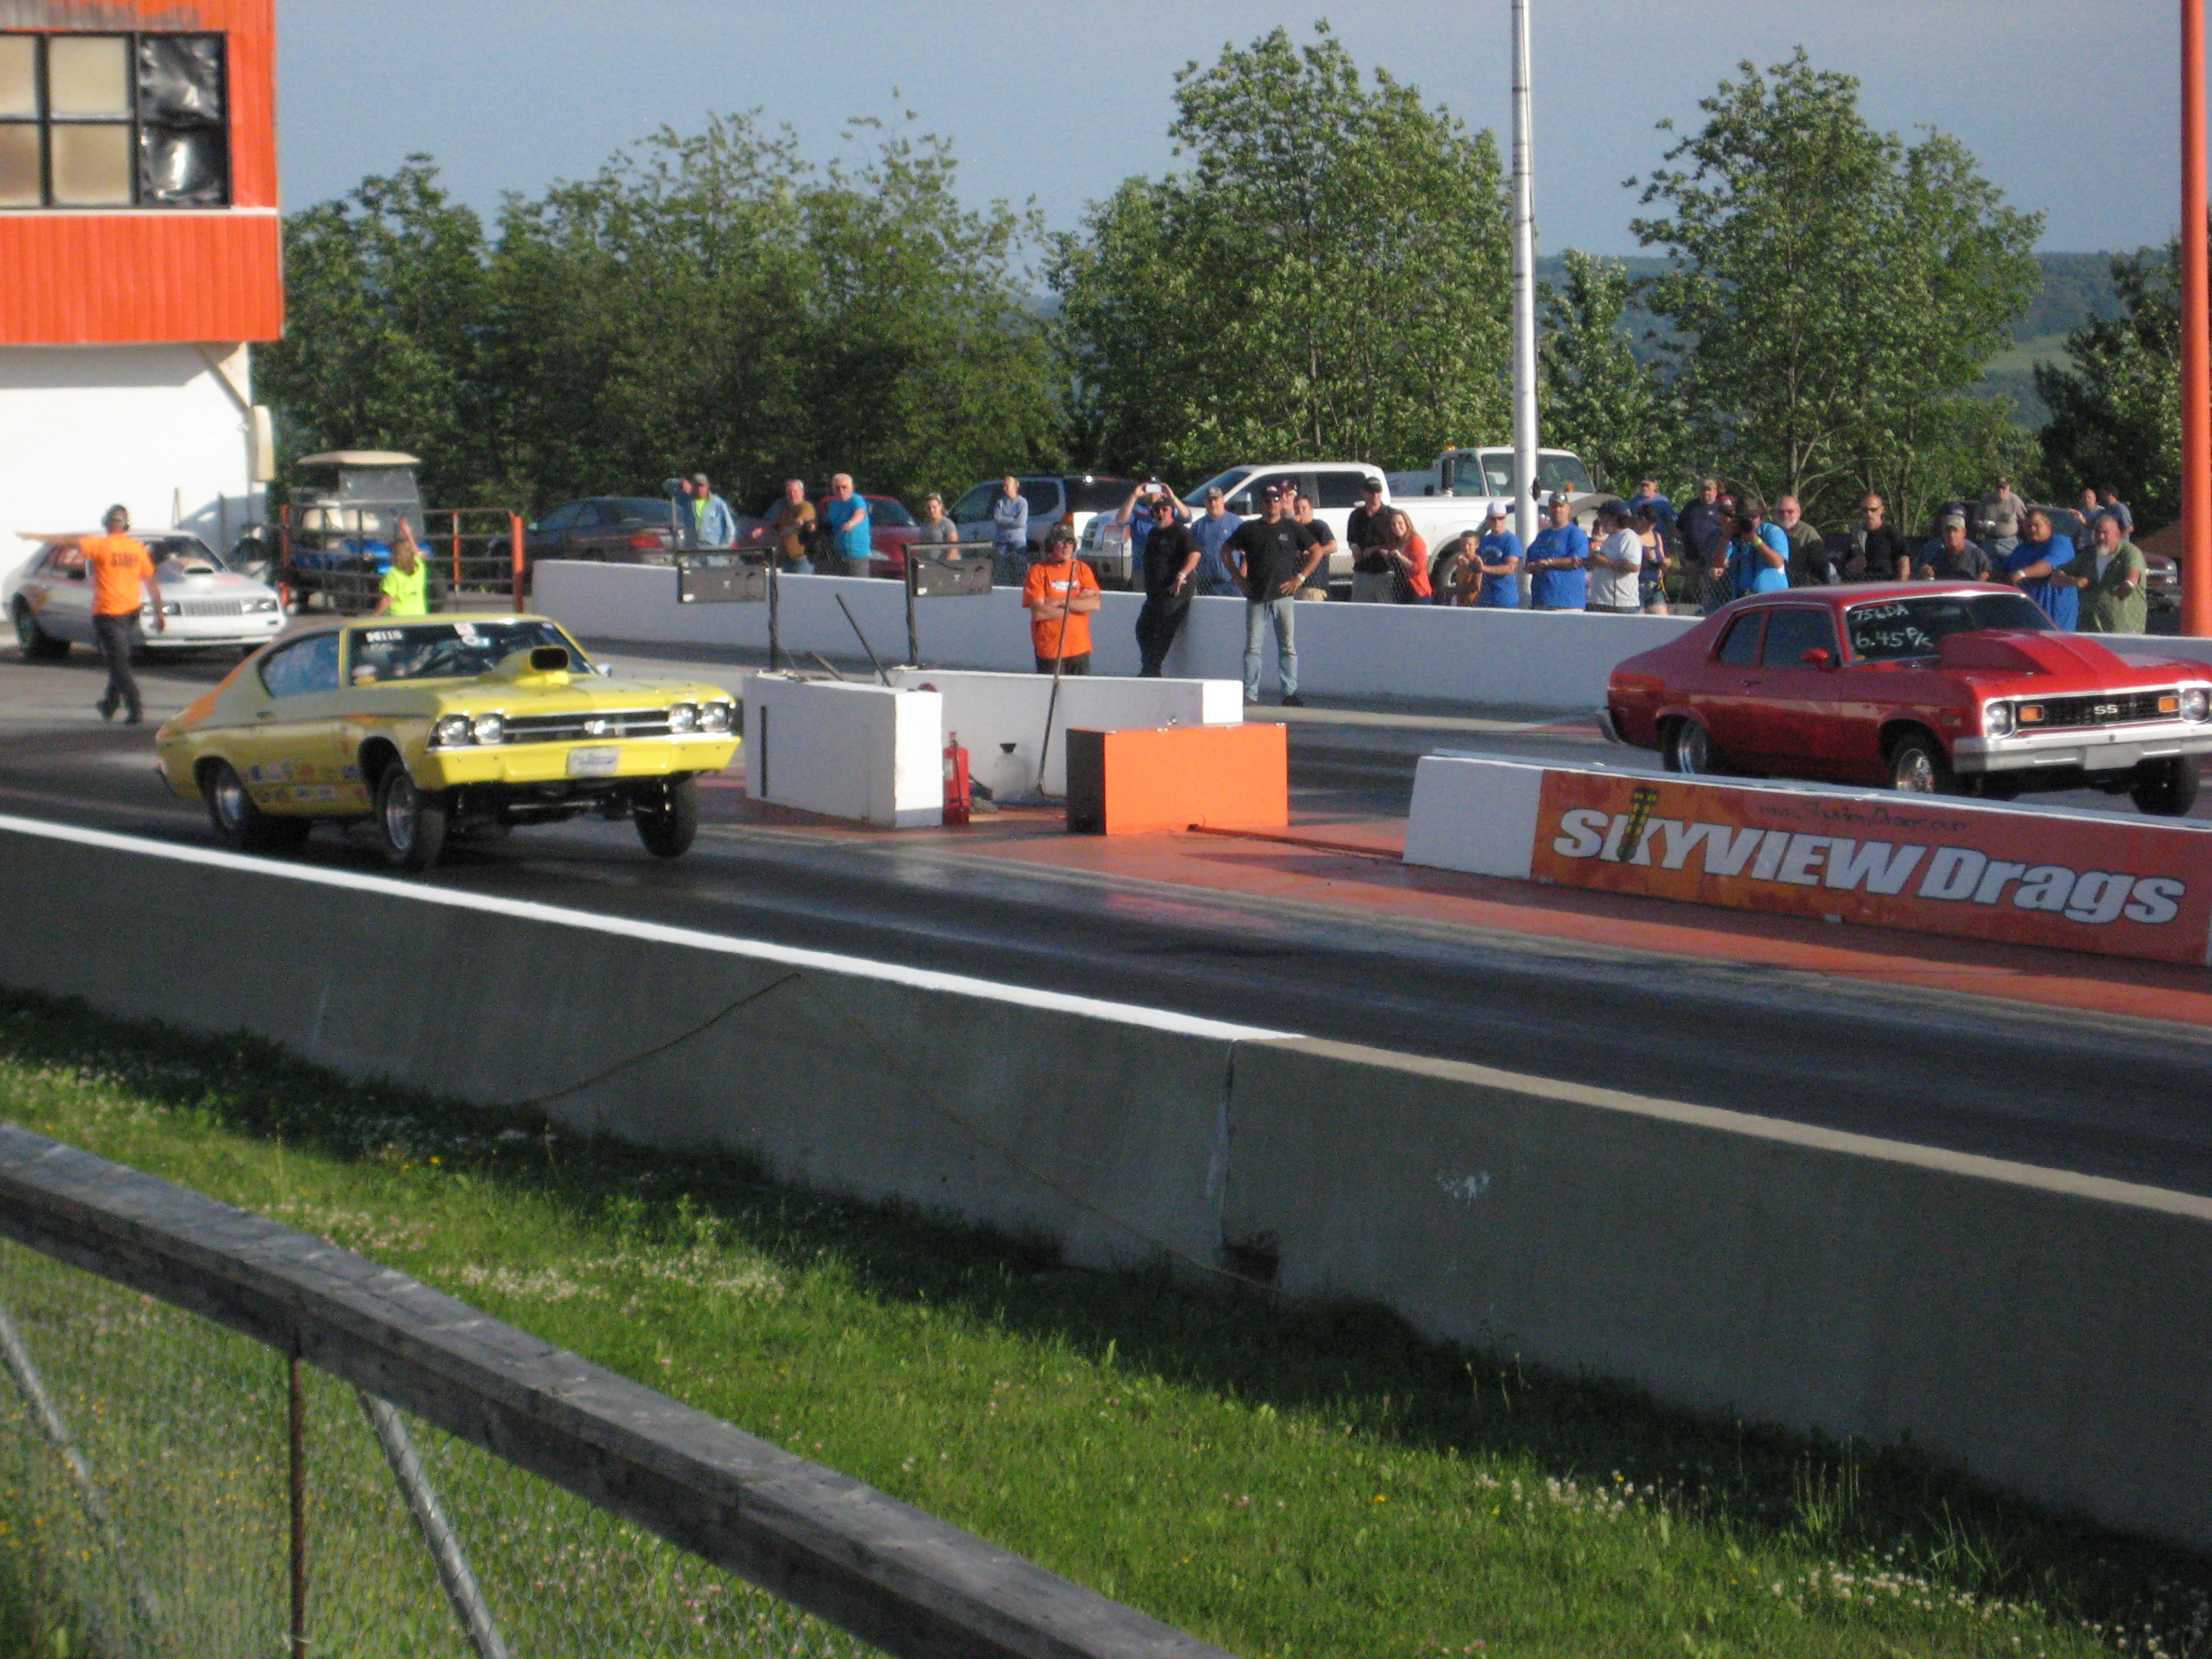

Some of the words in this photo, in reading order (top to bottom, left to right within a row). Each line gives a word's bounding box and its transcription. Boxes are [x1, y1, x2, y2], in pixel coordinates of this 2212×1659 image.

[2094, 704, 2118, 714] SS
[1552, 808, 1928, 896] SKYVIEW
[1917, 845, 2186, 925] Drags
